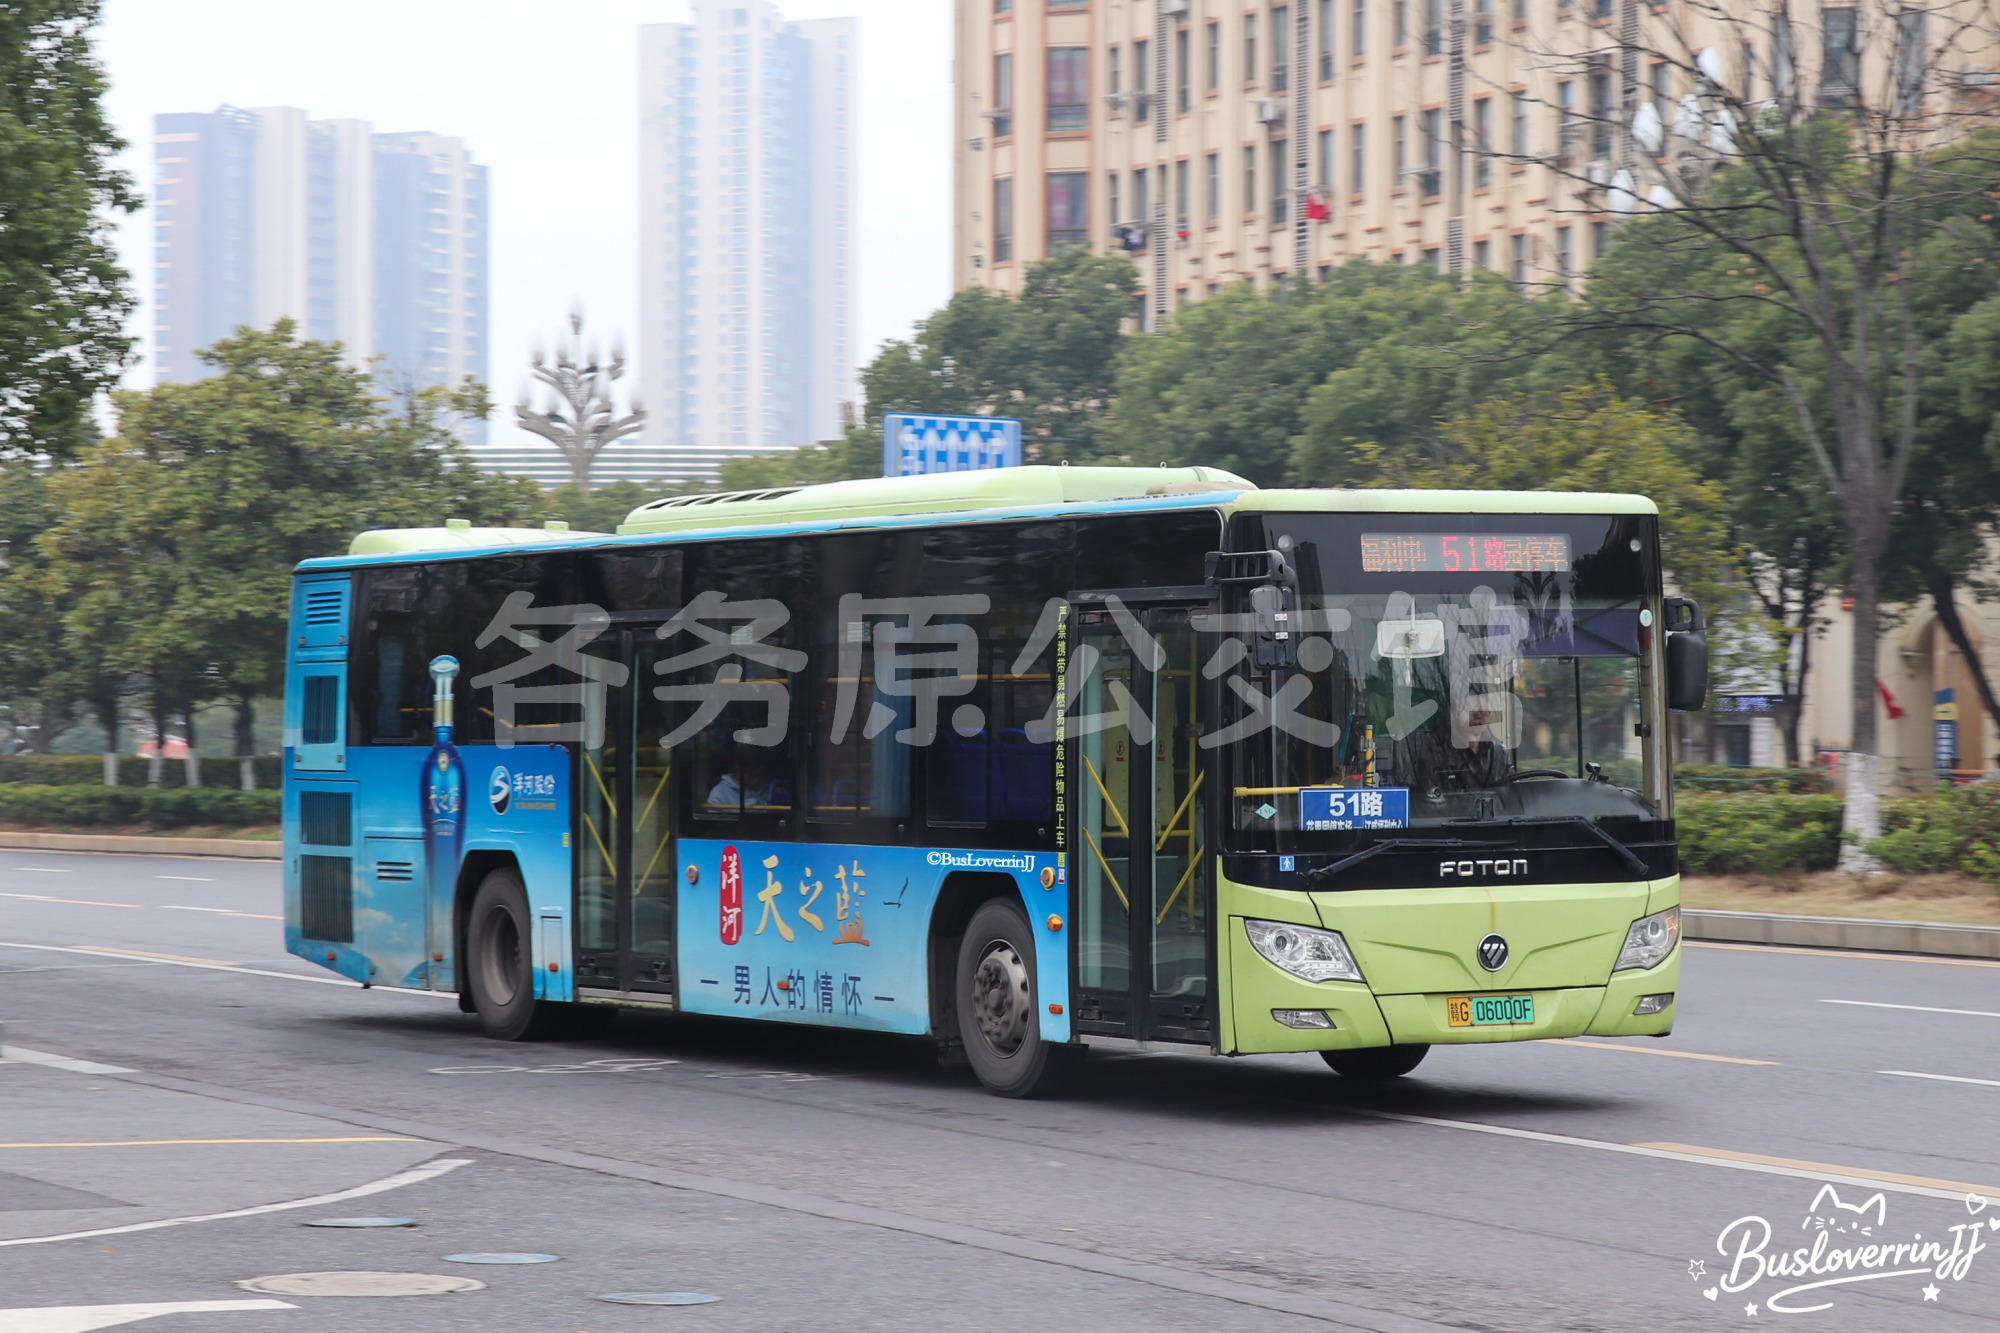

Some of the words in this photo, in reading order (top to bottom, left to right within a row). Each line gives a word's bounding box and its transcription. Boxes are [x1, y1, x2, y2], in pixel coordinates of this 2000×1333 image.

[1503, 536, 1568, 572] 园停车
[1056, 606, 1067, 848] 严禁携带易燃易爆危险物品上车
[1329, 792, 1383, 817] 51路
[1440, 859, 1529, 878] FOTON
[722, 853, 741, 941] 洋河
